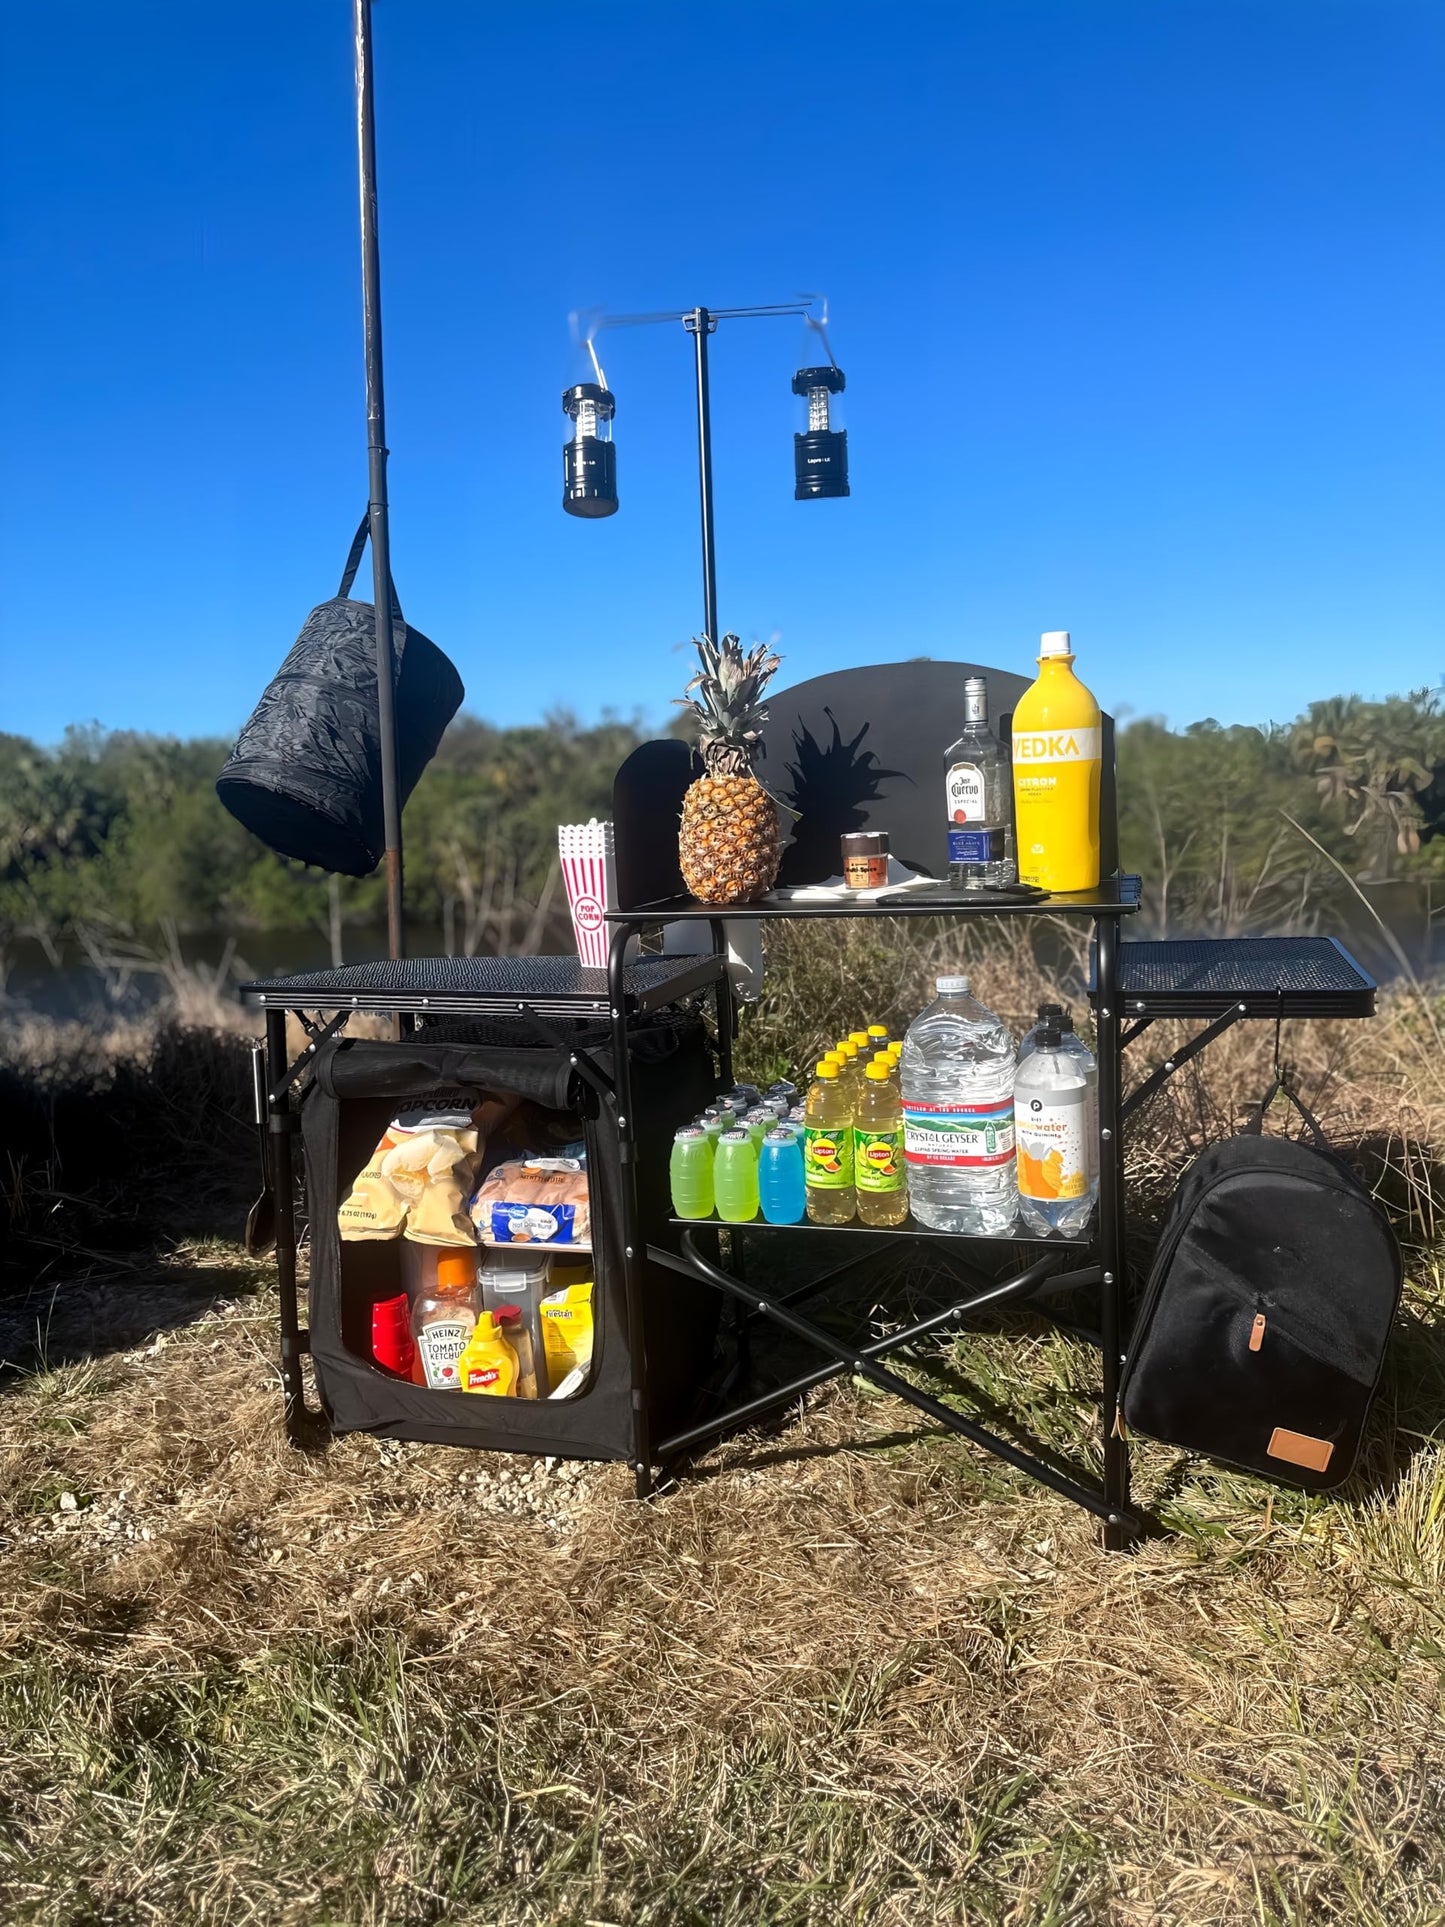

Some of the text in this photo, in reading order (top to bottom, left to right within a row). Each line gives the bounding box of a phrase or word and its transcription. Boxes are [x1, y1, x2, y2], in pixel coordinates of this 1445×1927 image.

[1018, 776, 1057, 787] CITRON
[951, 782, 979, 798] Cuervo
[580, 904, 596, 913] POP
[578, 912, 600, 921] CORN
[907, 1130, 940, 1143] CRYSTAL
[942, 1133, 978, 1144] GEYSER
[814, 1147, 834, 1156] Lipton
[869, 1151, 890, 1159] Lipton
[512, 1222, 523, 1230] Hot
[432, 1328, 461, 1340] HEINZ
[428, 1341, 467, 1354] TOMATO
[430, 1350, 466, 1361] KETCHU
[469, 1370, 498, 1386] French's
